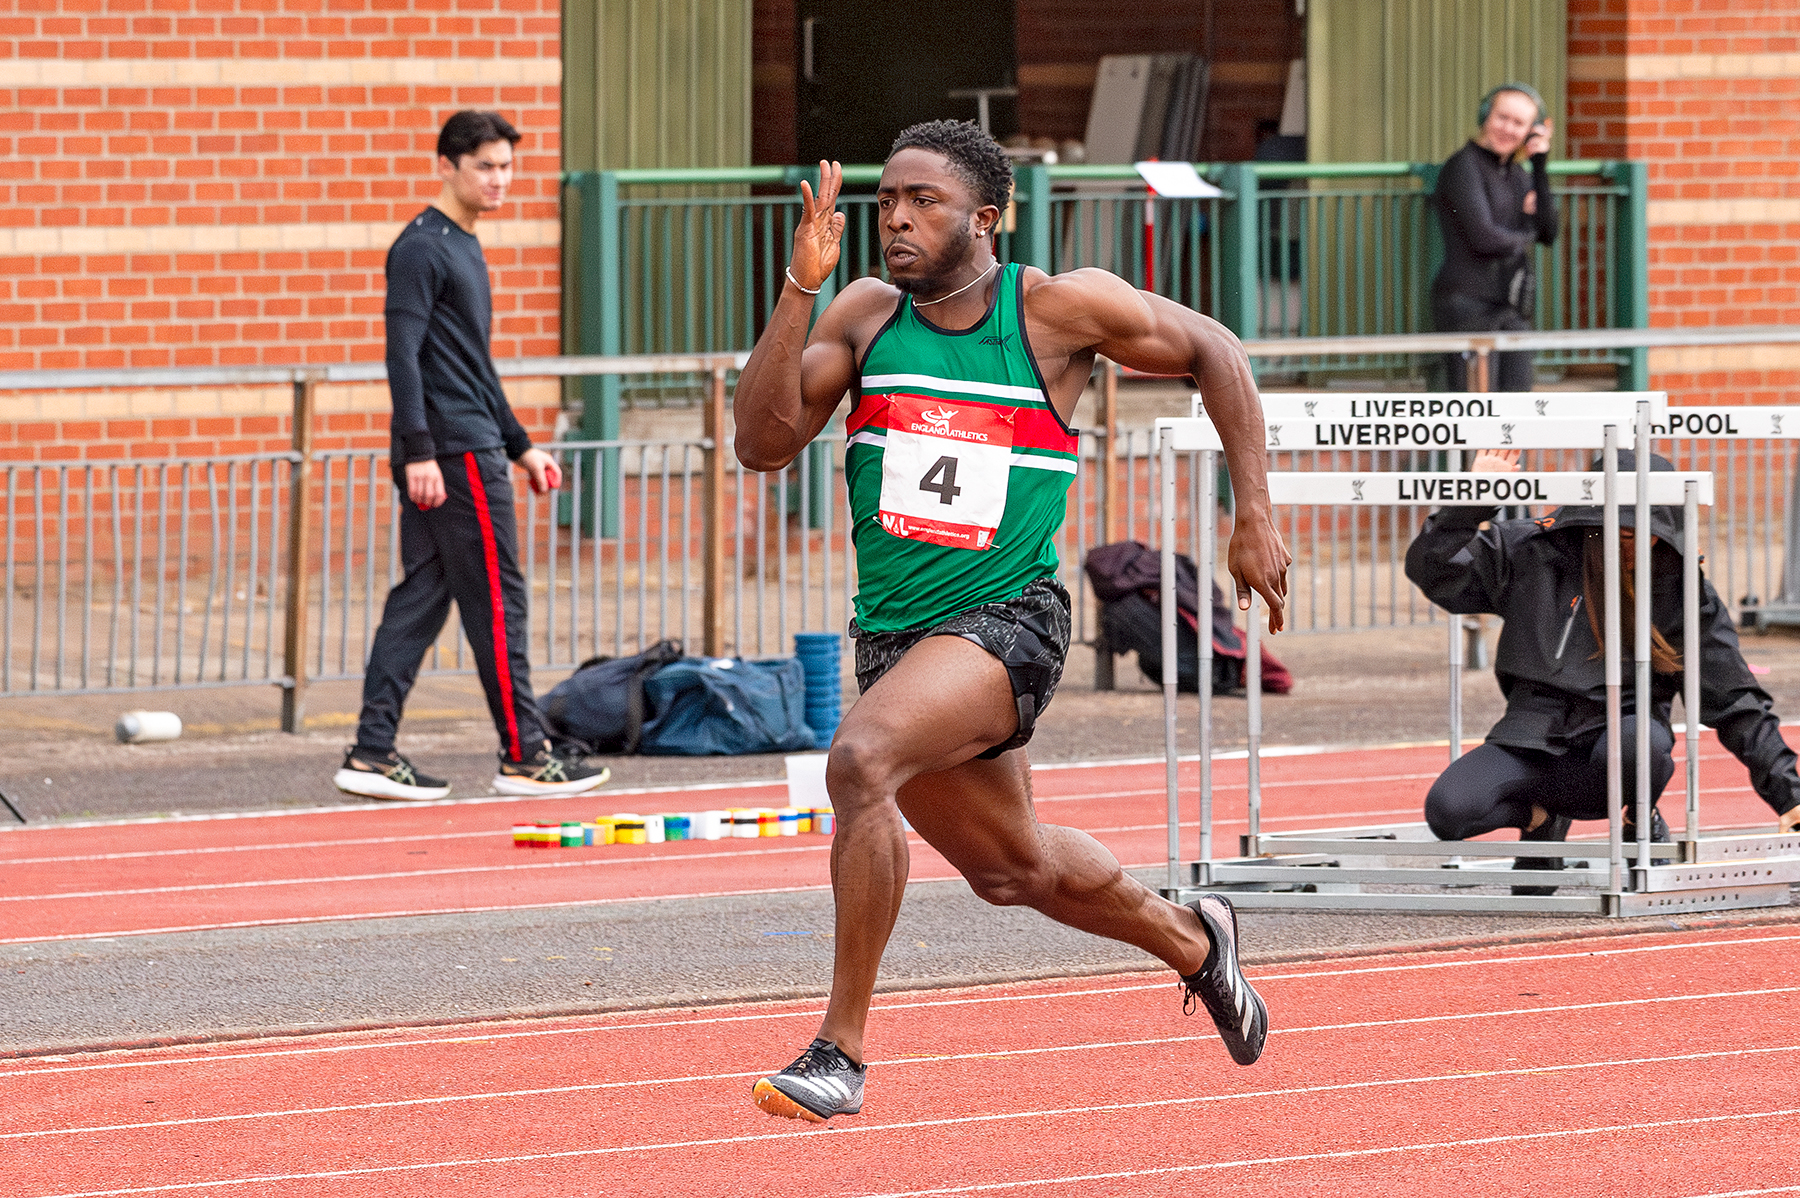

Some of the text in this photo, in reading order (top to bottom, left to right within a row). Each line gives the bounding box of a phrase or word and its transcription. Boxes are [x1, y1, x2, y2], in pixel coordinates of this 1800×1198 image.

[1350, 399, 1501, 418] LIVERPOOL
[911, 422, 988, 441] ENGLAND ATHLETICS
[1315, 422, 1467, 446] LIVERPOOL
[918, 455, 962, 506] 4
[1398, 478, 1548, 501] LIVERPOOL
